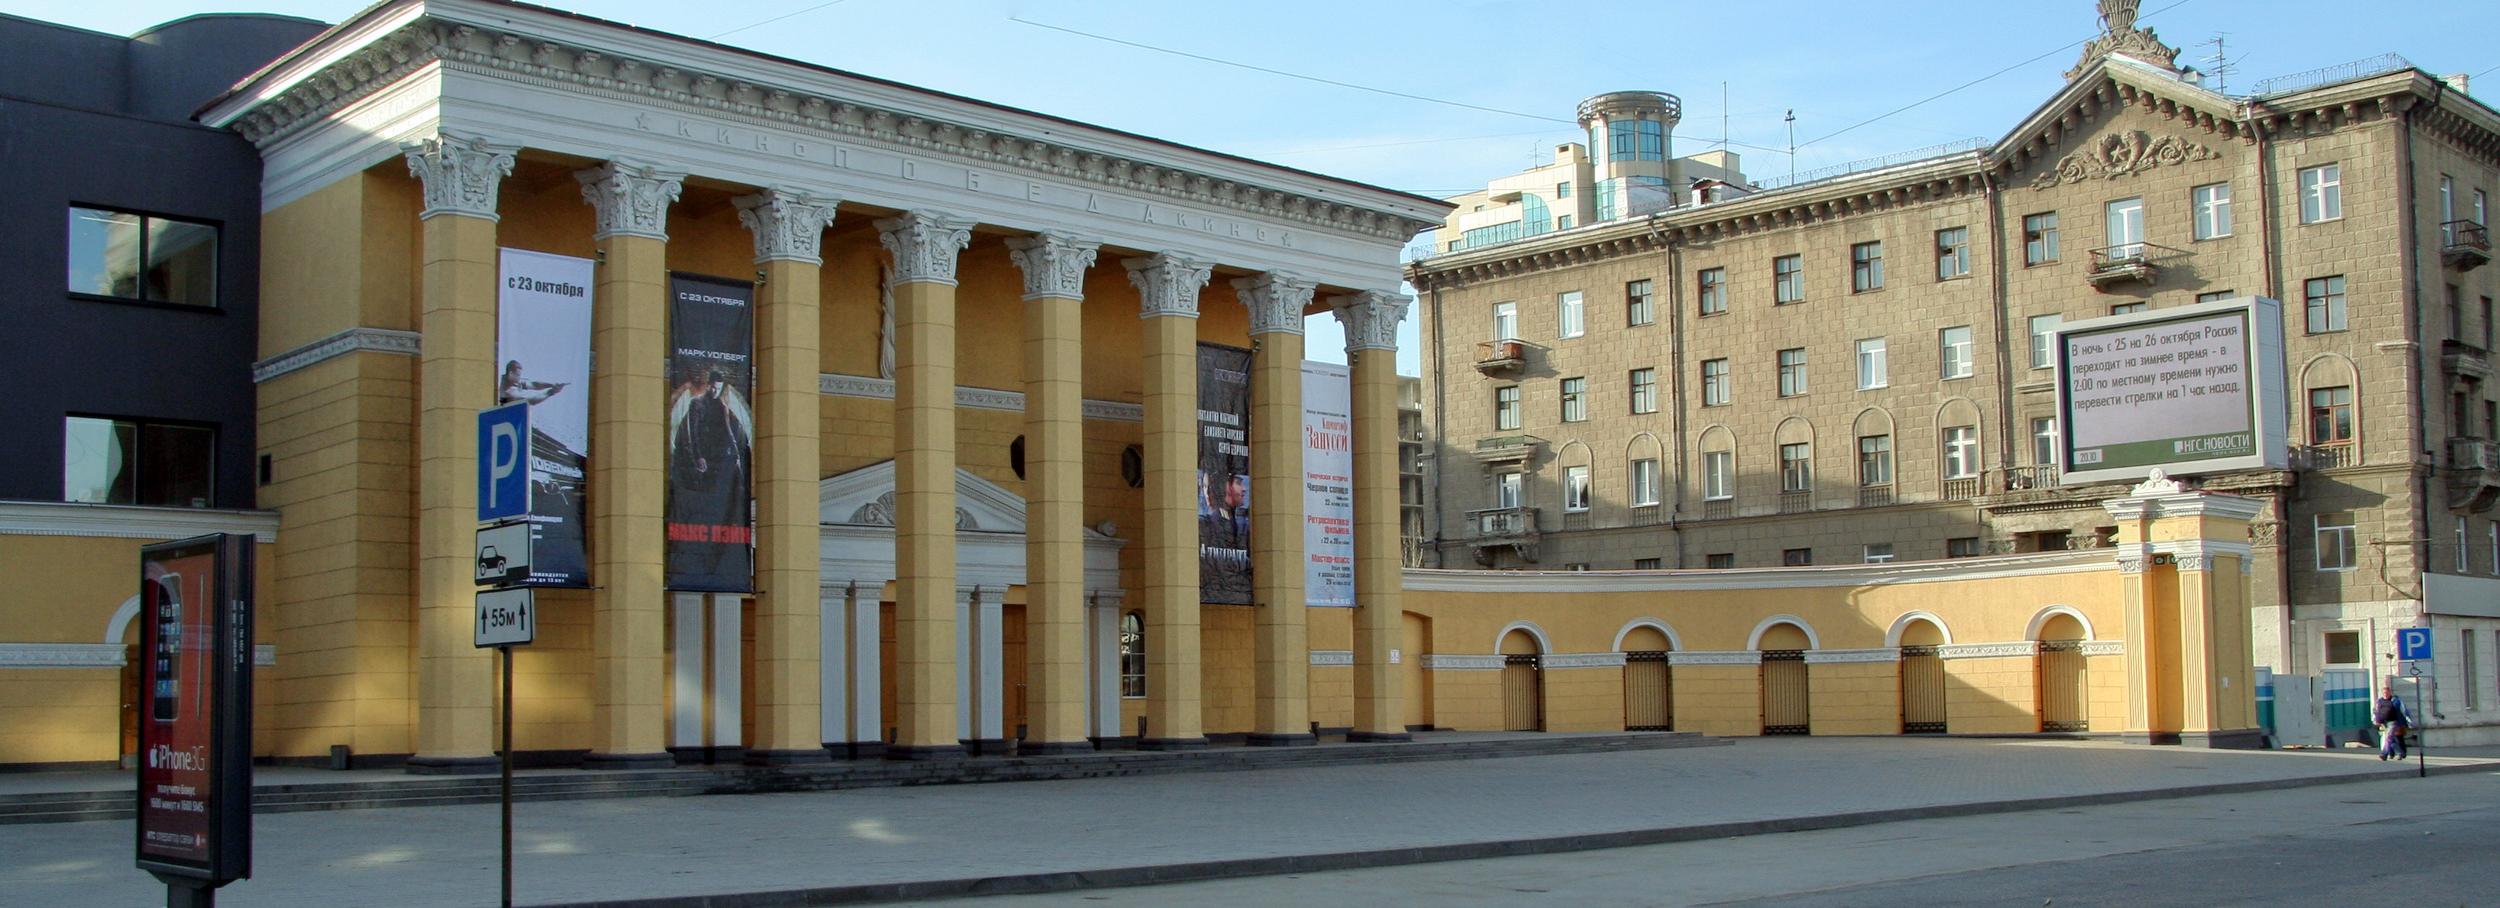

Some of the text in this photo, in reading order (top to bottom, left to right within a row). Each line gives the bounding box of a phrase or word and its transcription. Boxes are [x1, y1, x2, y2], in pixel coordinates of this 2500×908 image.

[677, 113, 1266, 242] КИНО ПОБЕДА КИНО
[508, 276, 585, 298] с 23 октября
[680, 291, 745, 307] С 23 ОКТЯБРЯ
[2072, 325, 2238, 357] В ночь с 25 на 26 октября Россия
[678, 348, 746, 363] МАРК УОЛБЕРГ
[2072, 360, 2120, 377] переходит
[2125, 356, 2136, 367] на
[2140, 352, 2174, 366] зимнее
[2177, 347, 2208, 364] время
[2220, 346, 2227, 355] в
[2073, 362, 2238, 392] 2:00 по местному времени нужно
[2074, 380, 2241, 412] перевести стрелки на 1 час назад.
[490, 421, 519, 508] P
[668, 523, 708, 542] МАКС
[491, 607, 515, 627] 55м
[2406, 631, 2426, 657] P
